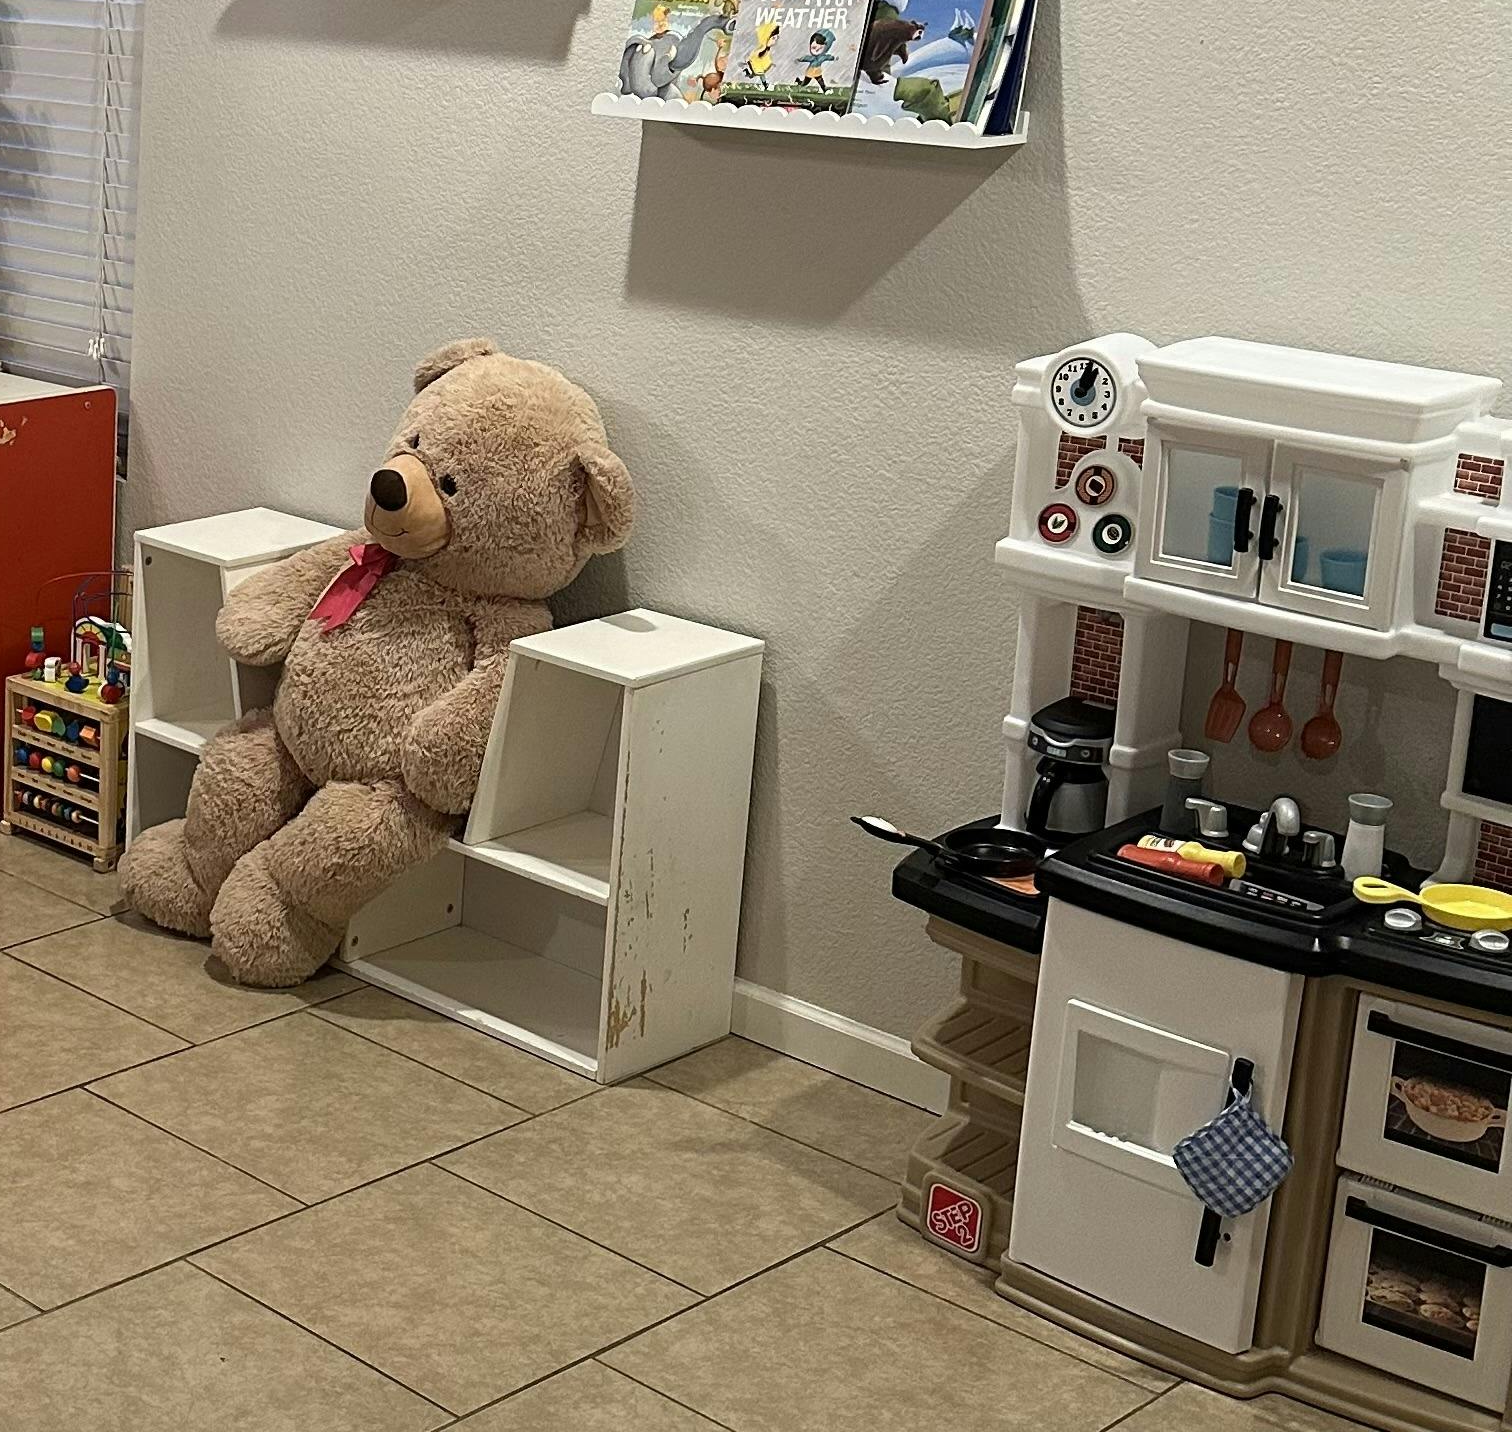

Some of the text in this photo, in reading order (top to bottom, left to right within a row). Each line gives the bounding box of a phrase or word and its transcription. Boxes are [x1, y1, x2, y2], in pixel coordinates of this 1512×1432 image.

[755, 6, 848, 30] WEATHER
[1068, 365, 1077, 373] 11
[1059, 373, 1069, 381] 10
[1102, 378, 1109, 386] 2
[1055, 385, 1062, 393] 9
[1104, 390, 1111, 398] 3
[1058, 398, 1065, 406] 8
[1101, 403, 1107, 411] 4
[1067, 409, 1073, 417] 7
[1092, 412, 1098, 420] 5
[1079, 413, 1085, 422] 6
[932, 1201, 973, 1233] STEP
[955, 1224, 974, 1246] 2
